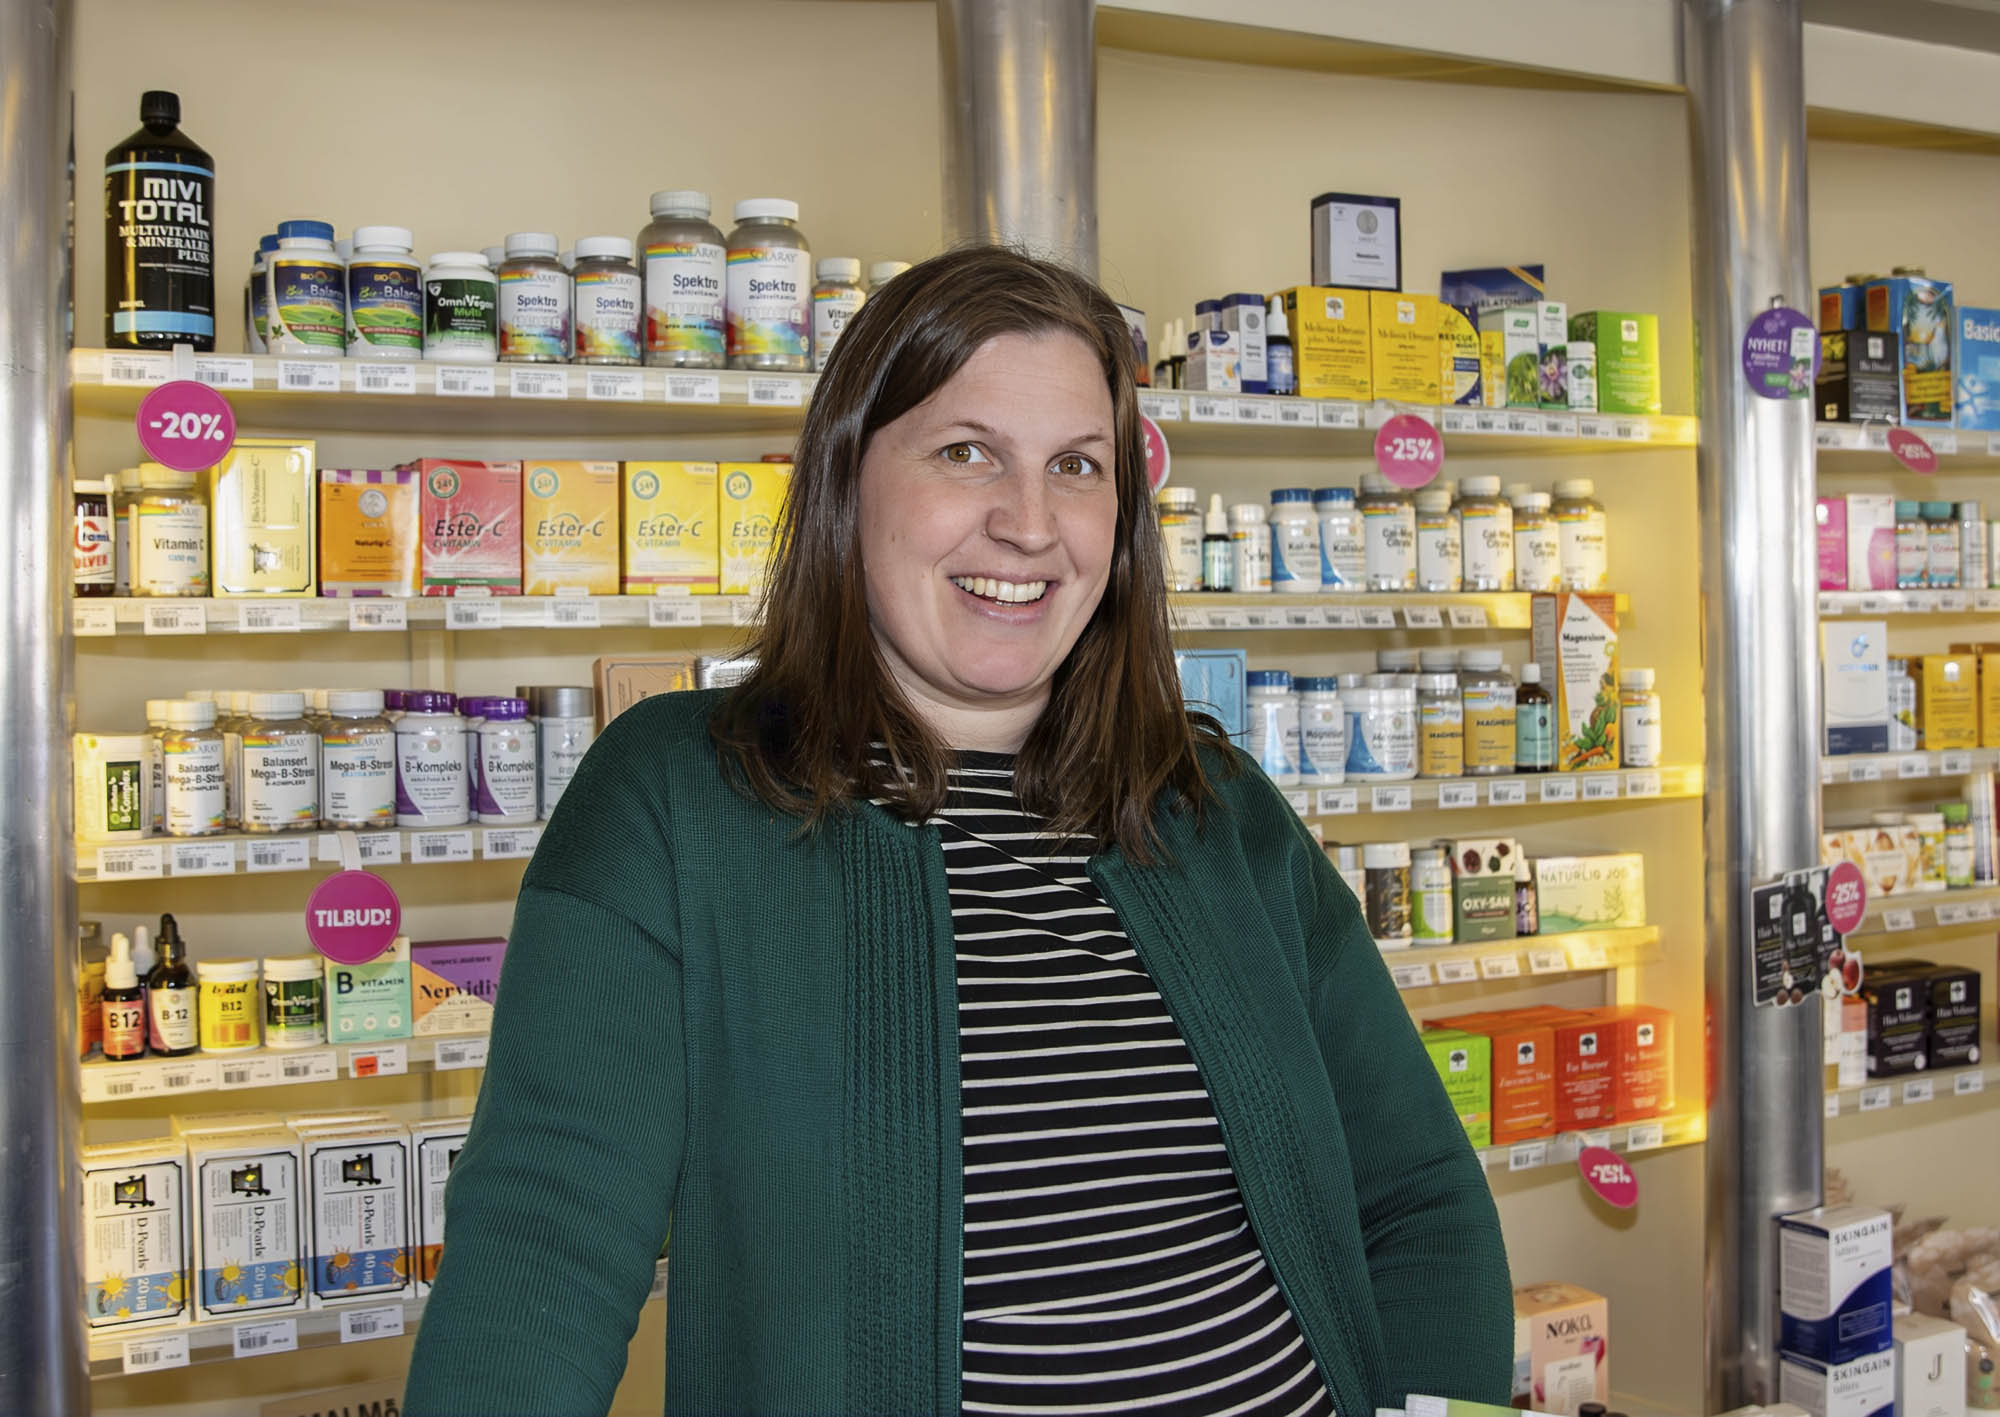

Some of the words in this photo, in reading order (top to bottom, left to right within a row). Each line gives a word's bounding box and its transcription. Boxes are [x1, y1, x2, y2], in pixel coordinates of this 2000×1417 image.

[143, 177, 202, 203] MIVI
[119, 199, 209, 226] TOTAL
[119, 224, 209, 240] MULTIVITAMIN
[138, 237, 209, 252] MINERALER
[177, 248, 209, 264] PLUSS
[672, 274, 719, 290] Spektro
[749, 279, 797, 294] Spektro
[517, 295, 558, 306] Spektro
[596, 297, 635, 310] Spektro
[1747, 338, 1787, 354] NYHET!
[150, 412, 225, 441] -20%
[1384, 438, 1436, 462] -25%
[434, 519, 505, 537] Ester-C
[537, 520, 605, 537] Ester-C
[638, 520, 703, 537] Ester-C
[153, 538, 198, 550] Vitamin
[1563, 632, 1606, 643] Magnesium
[178, 763, 220, 773] Balansert
[263, 756, 308, 767] Balansert
[404, 762, 462, 774] B-Kompleks
[119, 769, 132, 823] B-Complex
[1462, 895, 1511, 911] OXY-SAN
[315, 908, 392, 927] TILBUD!
[336, 971, 354, 995] B
[360, 976, 405, 988] VITAMIN
[221, 1001, 242, 1011] B12
[110, 1011, 140, 1029] B12
[1834, 1221, 1888, 1244] SKINGAIN
[254, 1265, 266, 1281] 20
[136, 1278, 149, 1293] 20
[1833, 1358, 1891, 1382] SKINGAIN
[1928, 1353, 1942, 1381] J
